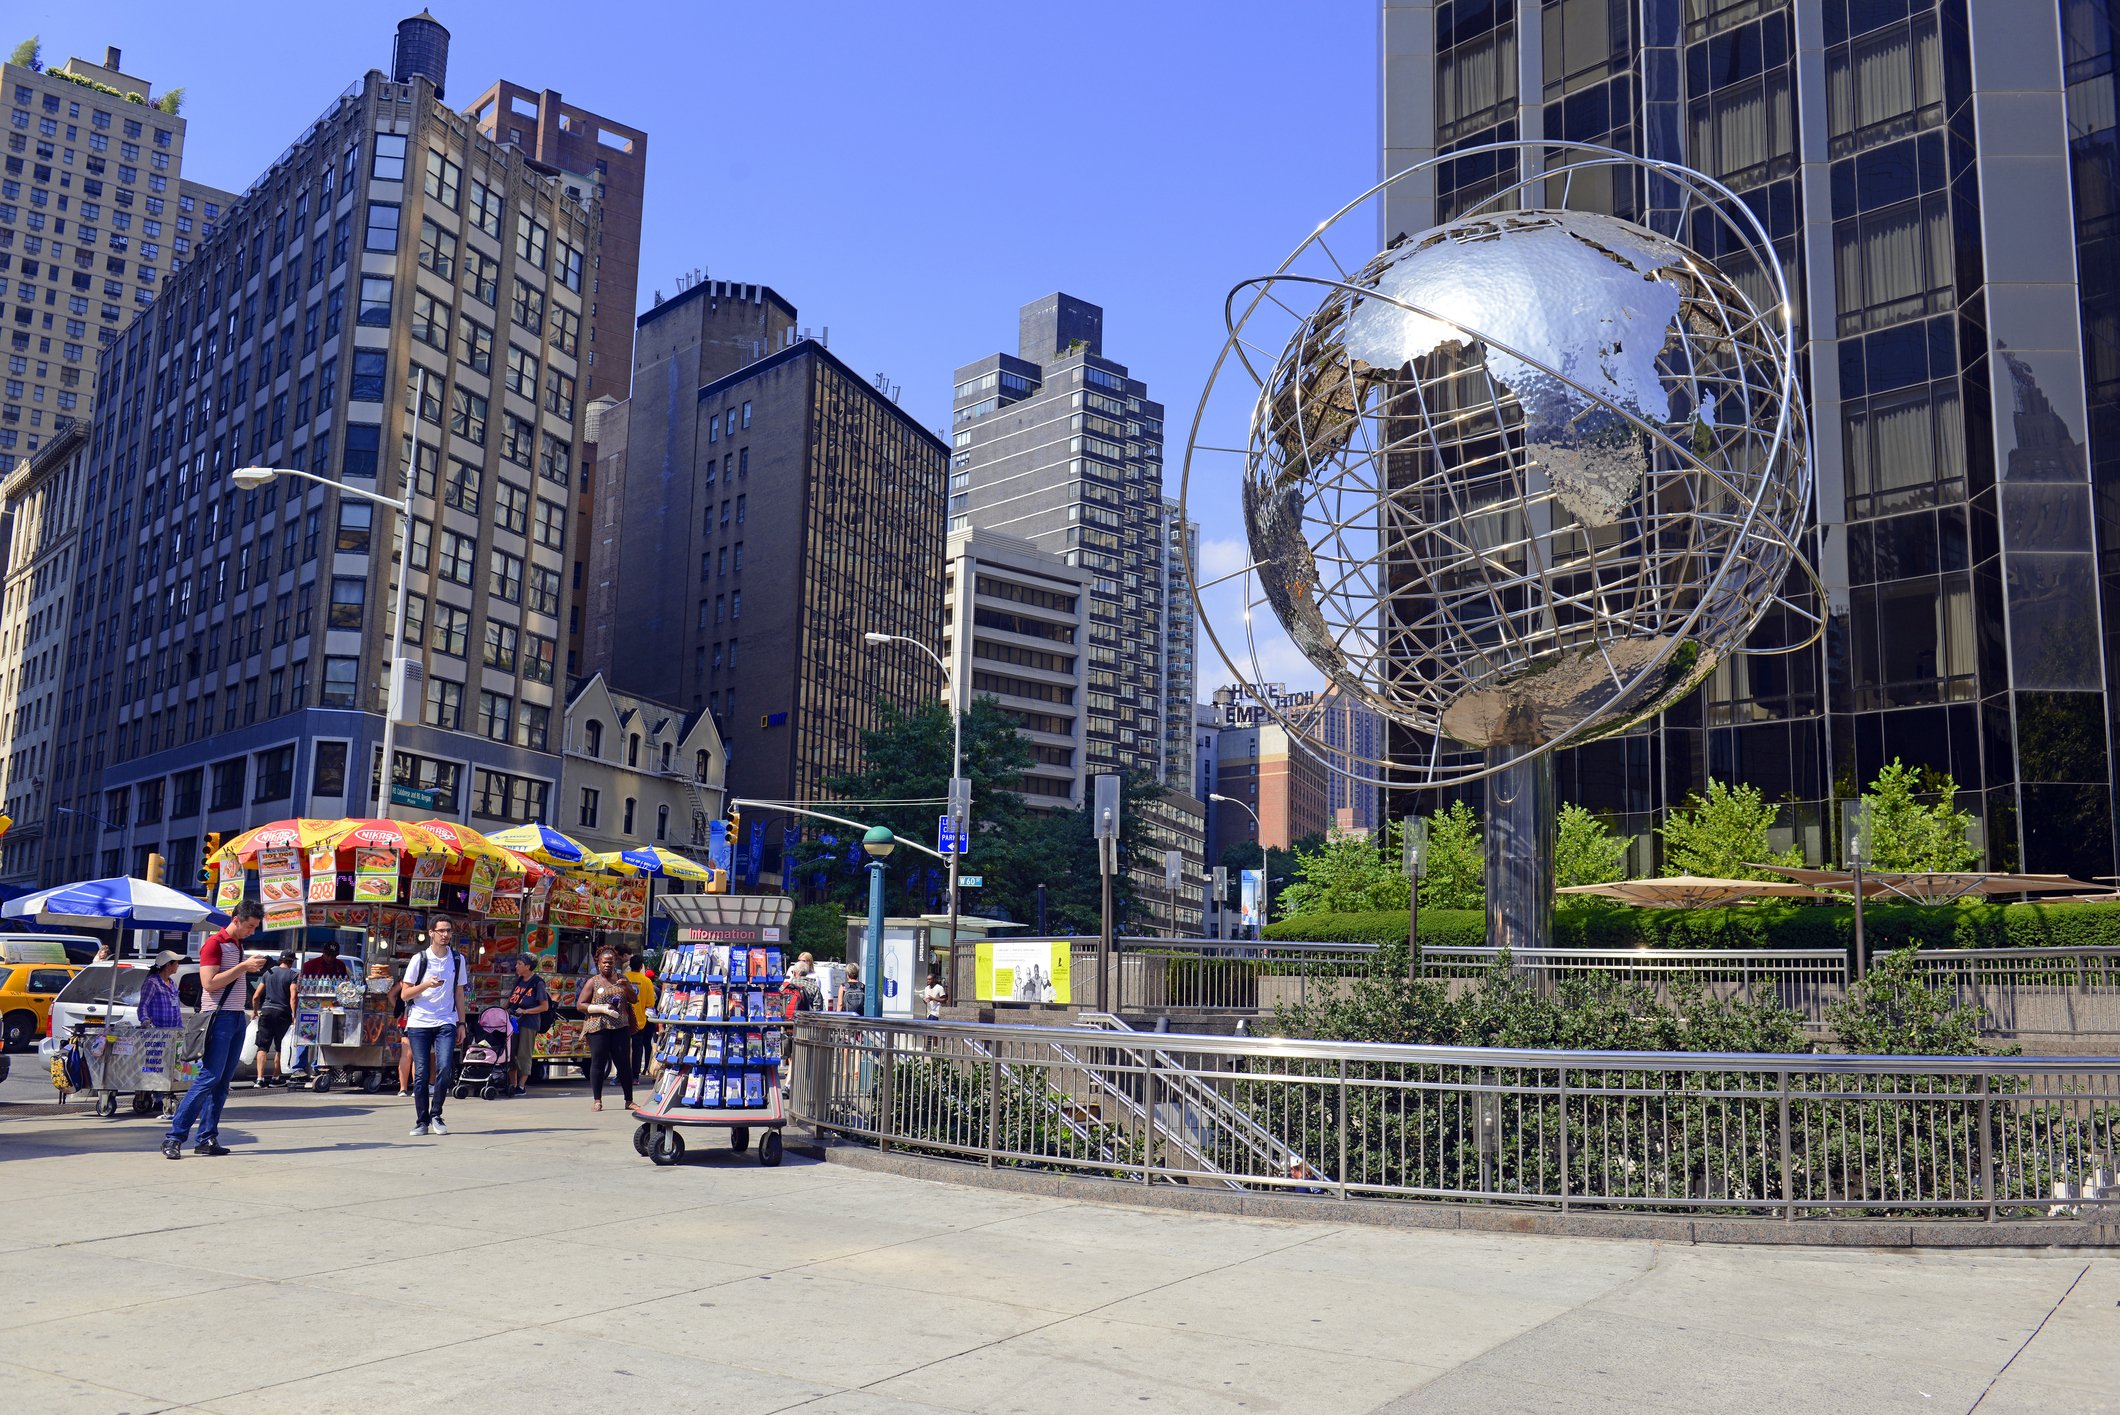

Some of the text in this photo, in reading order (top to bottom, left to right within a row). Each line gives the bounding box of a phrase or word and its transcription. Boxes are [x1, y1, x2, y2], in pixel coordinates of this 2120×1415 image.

[1232, 682, 1286, 699] HOTEL
[261, 831, 290, 842] NIKAS
[361, 831, 393, 841] NIKAS
[689, 927, 756, 940] Information
